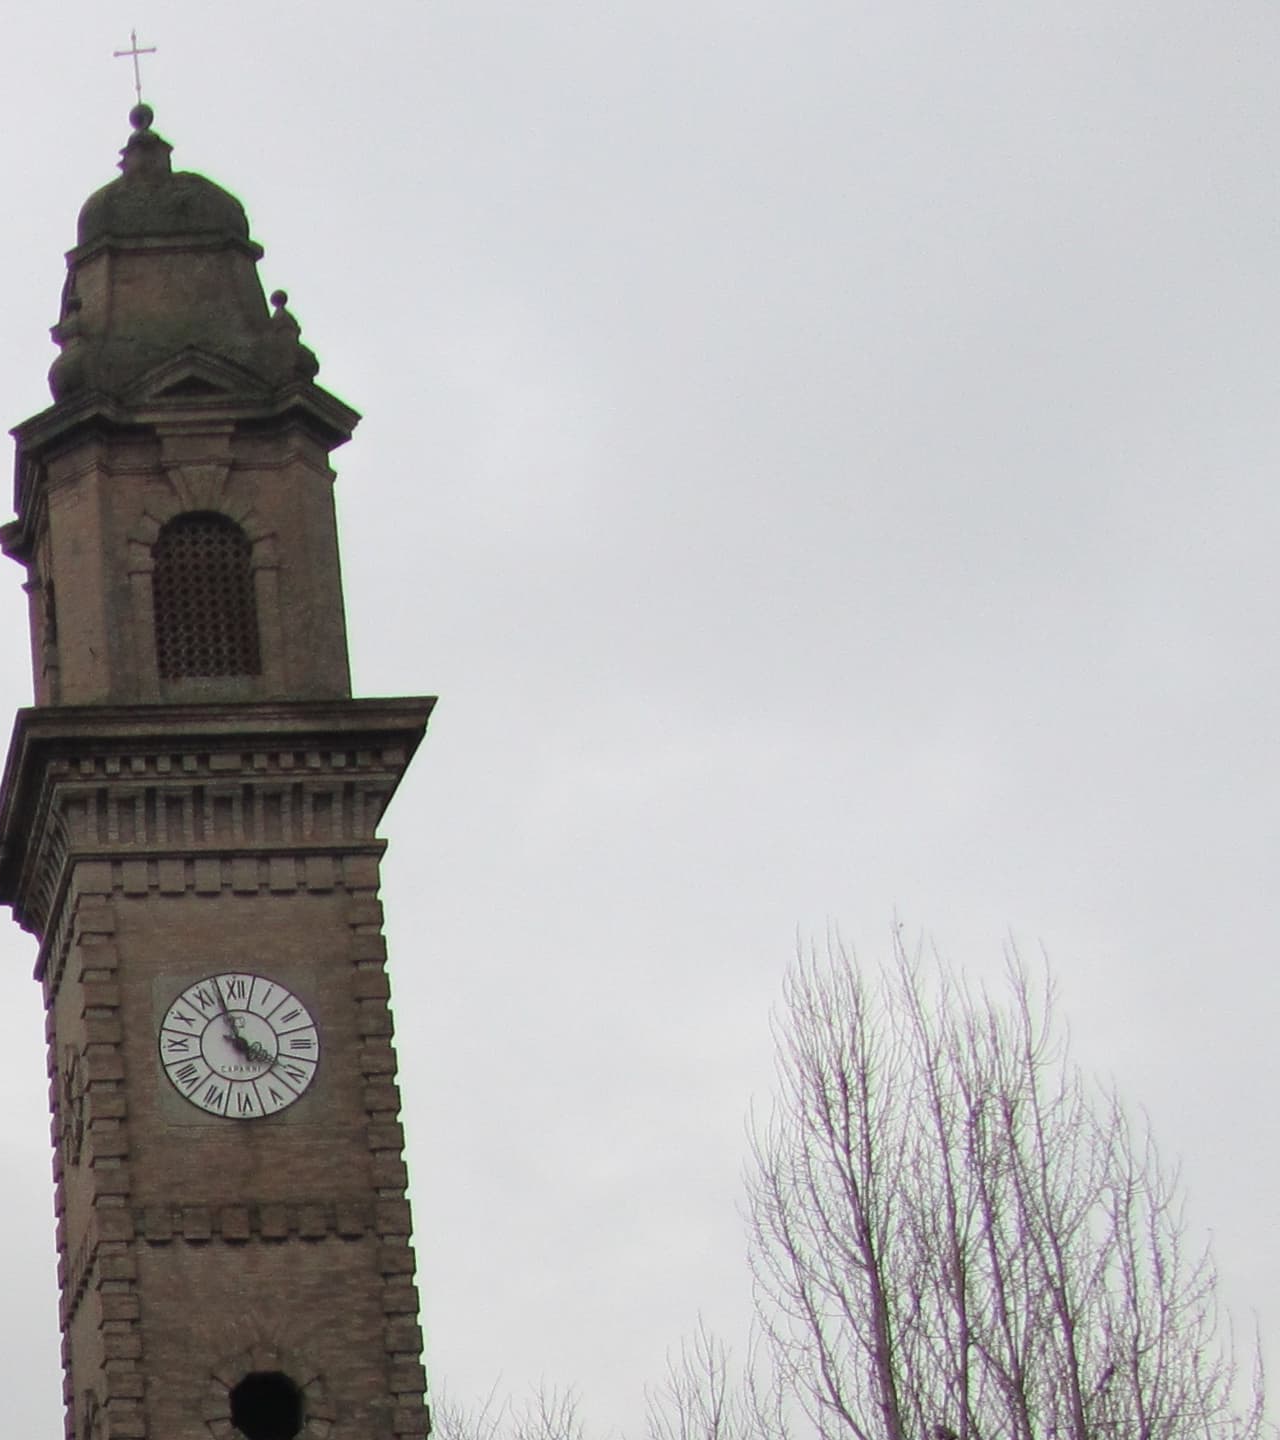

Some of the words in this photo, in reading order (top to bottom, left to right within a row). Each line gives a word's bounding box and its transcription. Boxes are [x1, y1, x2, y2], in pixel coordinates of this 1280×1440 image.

[192, 988, 215, 1010] XI
[226, 979, 245, 1000] XII
[261, 987, 272, 1005] I
[173, 1011, 196, 1027] X
[280, 1009, 301, 1023] II
[167, 1038, 189, 1052] IX
[289, 1038, 312, 1049] III
[175, 1064, 200, 1089] VIII
[285, 1063, 306, 1084] IV
[204, 1085, 224, 1109] VII
[237, 1092, 253, 1112] VI
[269, 1087, 284, 1105] V
